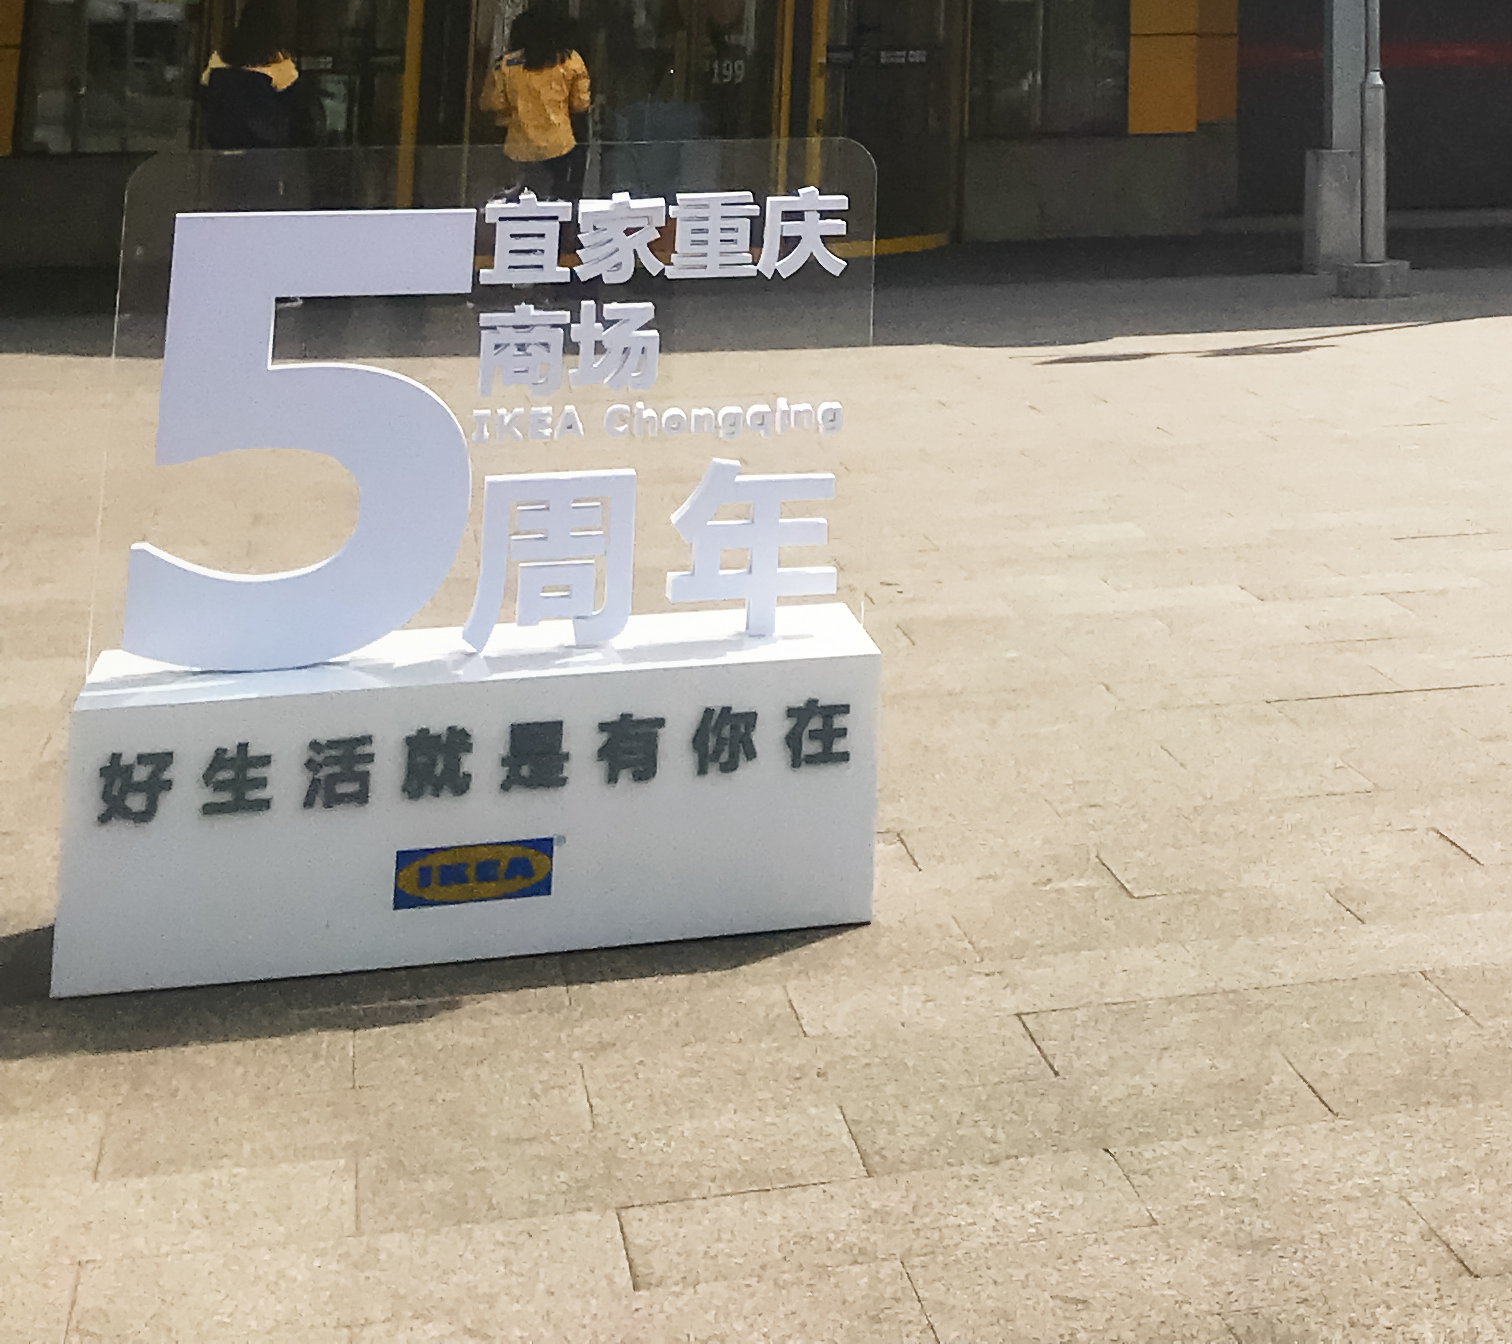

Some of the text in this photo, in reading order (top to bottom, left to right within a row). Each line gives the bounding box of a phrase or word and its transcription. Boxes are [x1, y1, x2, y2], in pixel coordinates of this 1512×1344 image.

[478, 185, 850, 285] 宜家重庆
[477, 299, 661, 398] 商场
[123, 208, 478, 672] 5
[471, 396, 844, 444] IKEA Chongqing
[461, 457, 838, 654] 周年
[95, 698, 853, 826] 好生活就是有你在
[416, 856, 536, 889] IKEA
